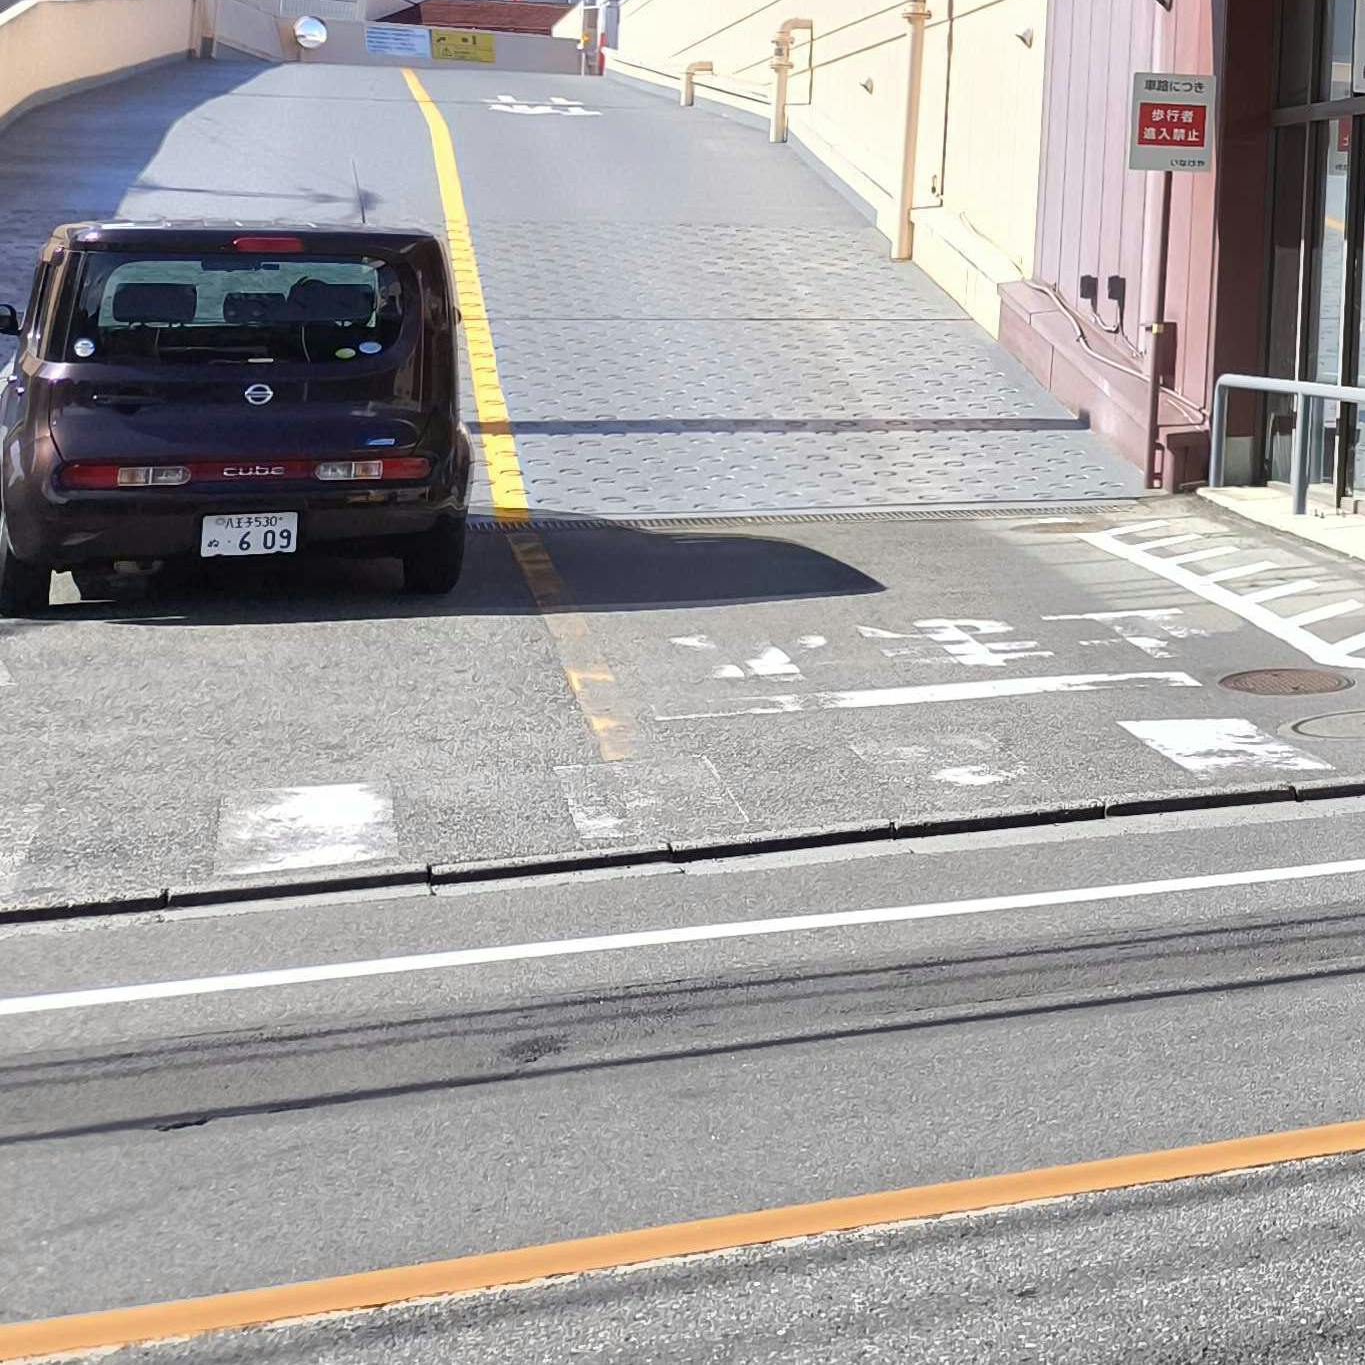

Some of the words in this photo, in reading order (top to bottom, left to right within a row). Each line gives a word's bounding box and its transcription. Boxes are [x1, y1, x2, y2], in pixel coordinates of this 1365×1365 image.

[1152, 109, 1194, 123] 歩行者
[1143, 127, 1200, 142] 進入禁止
[223, 465, 285, 477] cube
